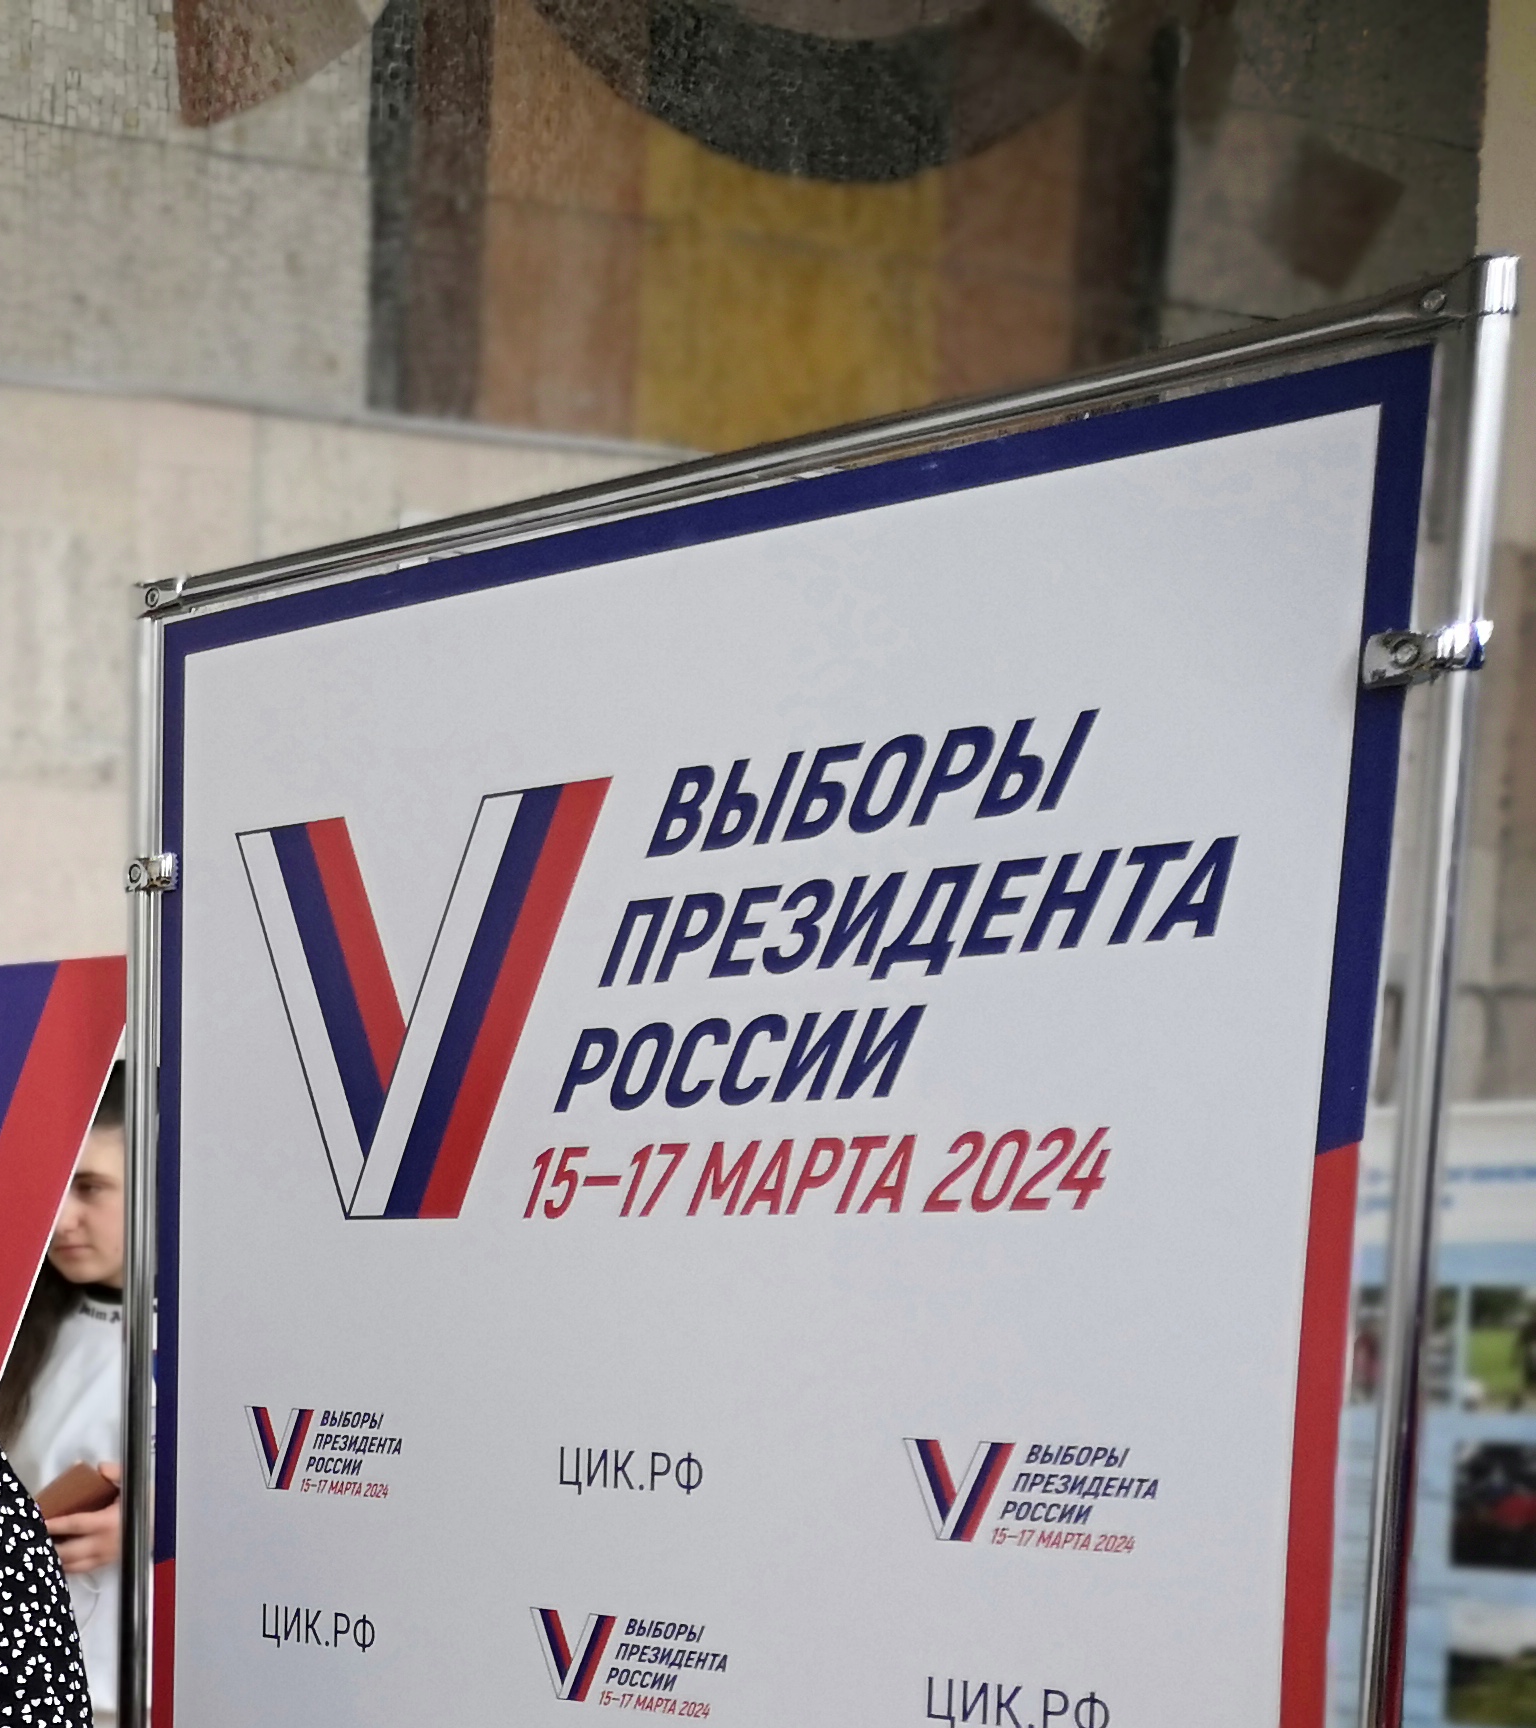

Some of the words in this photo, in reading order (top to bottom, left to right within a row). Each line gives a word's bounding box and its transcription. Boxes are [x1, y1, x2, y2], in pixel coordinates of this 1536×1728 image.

[646, 708, 1099, 858] ВЫБОРЫ
[598, 834, 1239, 989] ПРЕЗИДЕНТА
[553, 1003, 927, 1113] РОССИИ
[687, 1132, 917, 1216] МАРТА
[922, 1125, 1113, 1213] 2024
[319, 1410, 384, 1430] ВЫБОРЫ
[313, 1433, 402, 1455] ПРЕЗИДЕНТА
[1025, 1444, 1130, 1468] ВЫБОРЫ
[305, 1456, 363, 1476] РОССИИ
[558, 1446, 704, 1499] ЦИК.РФ
[328, 1481, 362, 1496] МАРТА
[363, 1483, 388, 1499] 2024
[1012, 1472, 1159, 1500] ПРЕЗИДЕНТА
[1000, 1500, 1094, 1525] РОССИИ
[1037, 1530, 1093, 1551] МАРТА
[1094, 1535, 1135, 1554] 2024
[260, 1603, 377, 1654] ЦИК.РФ
[624, 1618, 704, 1643] ВЫБОРЫ
[614, 1643, 728, 1672] ПРЕЗИДЕНТА
[605, 1667, 677, 1692] РОССИИ
[633, 1694, 676, 1715] МАРТА
[678, 1701, 711, 1719] 2024
